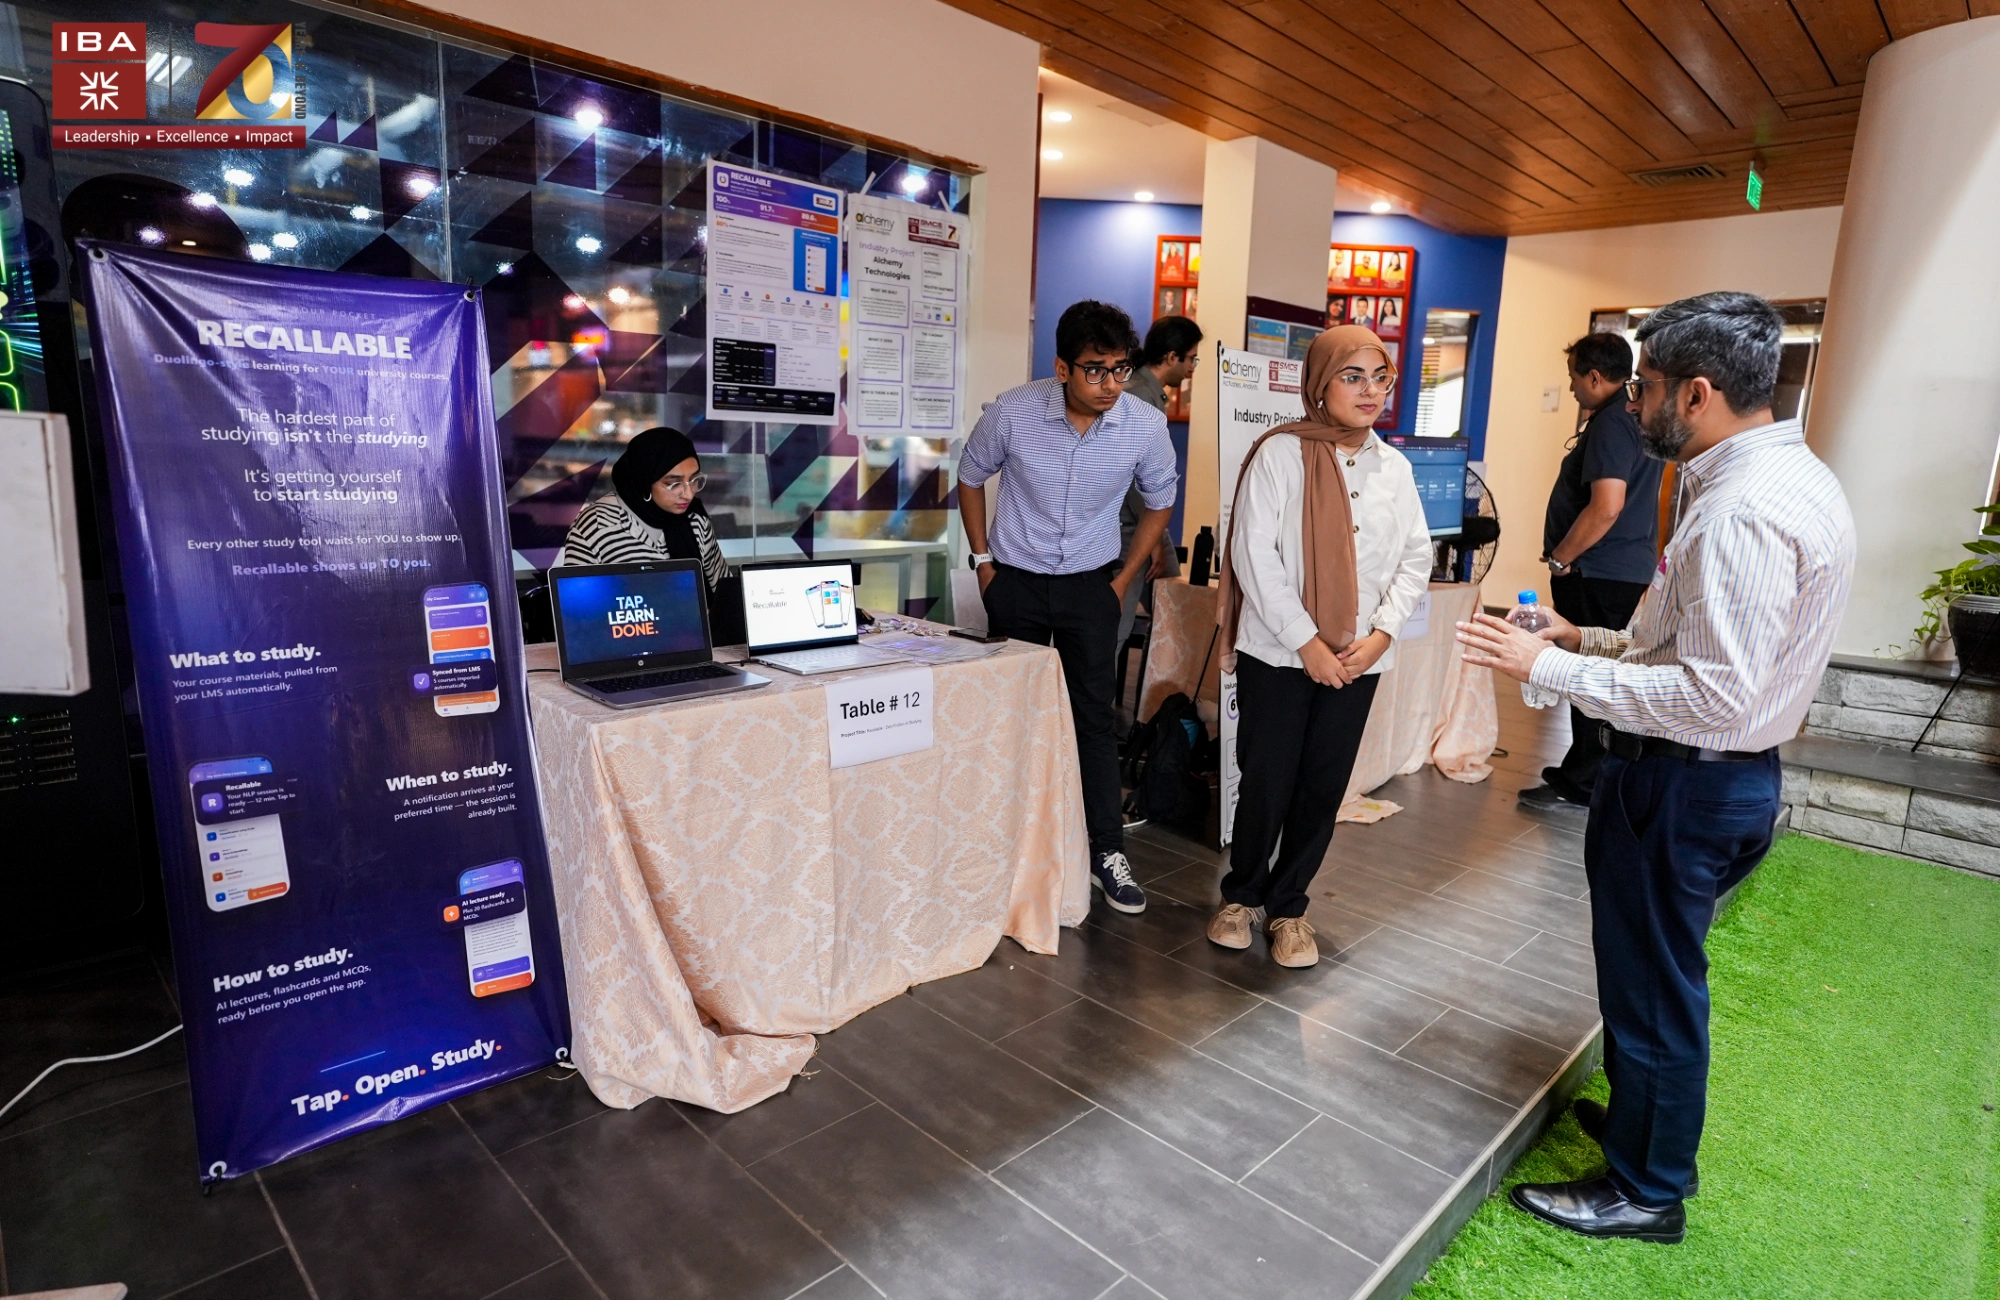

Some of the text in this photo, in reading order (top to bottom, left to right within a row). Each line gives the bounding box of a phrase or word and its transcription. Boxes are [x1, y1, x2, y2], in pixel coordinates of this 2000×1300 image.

[731, 172, 772, 188] RECALLABLE
[856, 212, 895, 231] alchemy
[859, 242, 915, 257] Industry Project
[873, 257, 903, 268] Alchemy
[865, 267, 911, 280] Technologies
[197, 320, 412, 360] RECALLABLE
[154, 354, 450, 380] Duolingo-style learning for YOUR university courses.
[1222, 358, 1262, 383] alchemy
[1280, 362, 1298, 371] SMCS
[236, 408, 395, 431] The hardest part of
[1235, 408, 1272, 427] Industry
[202, 426, 428, 448] studying isn't the studying
[244, 469, 402, 487] It's getting yourself
[253, 488, 398, 504] to start studying
[188, 534, 461, 551] Every other study tool waits for YOU to show up.
[232, 559, 431, 576] Recallable shows up TO you.
[616, 595, 647, 610] TAP.
[608, 608, 659, 625] LEARN.
[612, 622, 659, 639] DONE.
[169, 644, 321, 669] What to study.
[173, 665, 338, 688] Your course materials, pulled from
[432, 669, 453, 677] Synced
[174, 682, 293, 704] your LMS automatically.
[840, 692, 920, 719] Table # 12
[226, 781, 262, 791] Recallable
[386, 761, 513, 792] When to study.
[404, 799, 411, 807] A
[412, 792, 459, 805] notification
[460, 788, 486, 797] arrives
[498, 782, 515, 791] your
[394, 806, 433, 822] preferred
[435, 804, 453, 813] time
[481, 795, 508, 805] session
[468, 804, 517, 819] already built.
[470, 896, 488, 905] lecture
[490, 891, 505, 899] ready
[481, 900, 505, 910] flashcards
[213, 947, 354, 993] How to study.
[216, 965, 371, 1012] AI lectures, flashcards and MCQs,
[218, 980, 366, 1025] ready before you open the app.
[291, 1039, 502, 1116] Tap. Open. Study.
